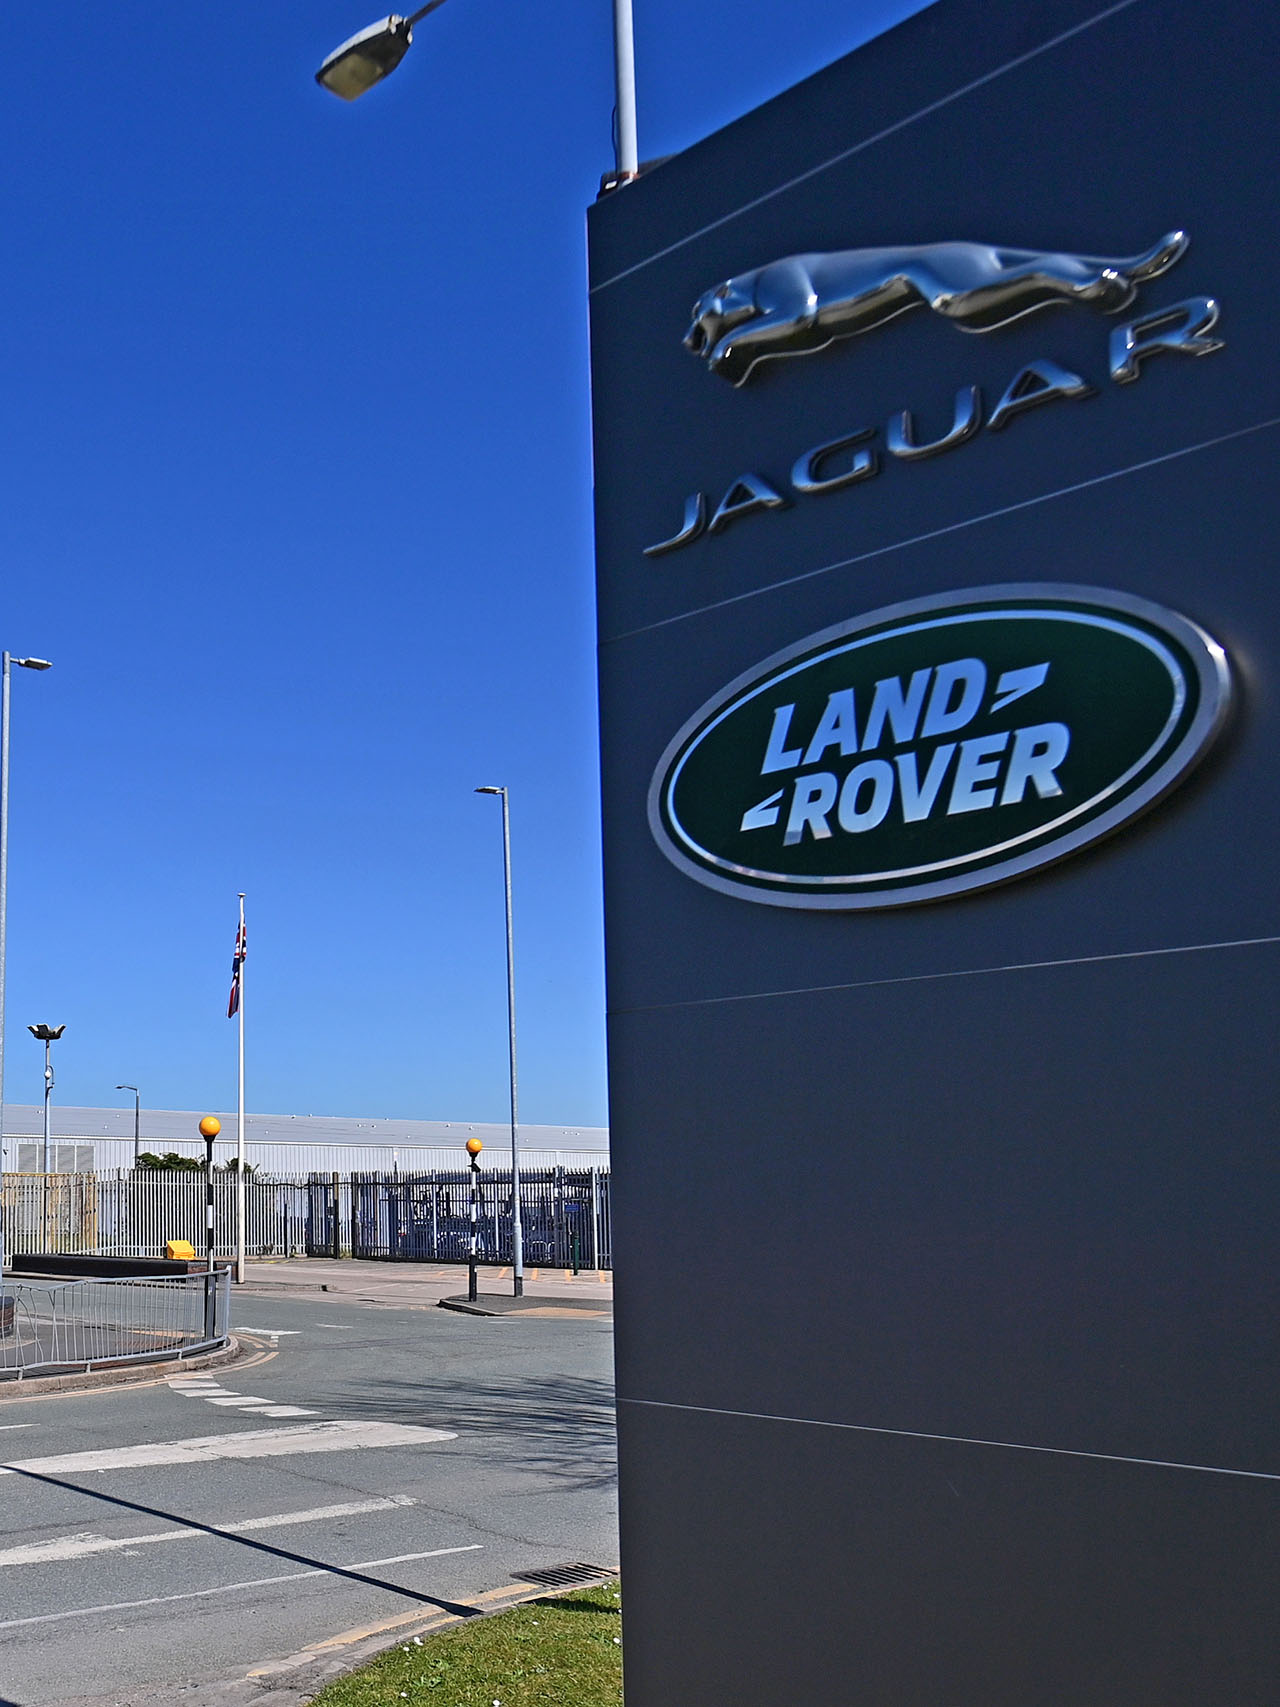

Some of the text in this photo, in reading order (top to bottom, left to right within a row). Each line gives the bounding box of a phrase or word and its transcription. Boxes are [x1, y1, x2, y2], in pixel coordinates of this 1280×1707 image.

[643, 296, 1225, 556] JAGUAR
[760, 657, 987, 775] LAND
[783, 722, 1070, 846] ROVER
